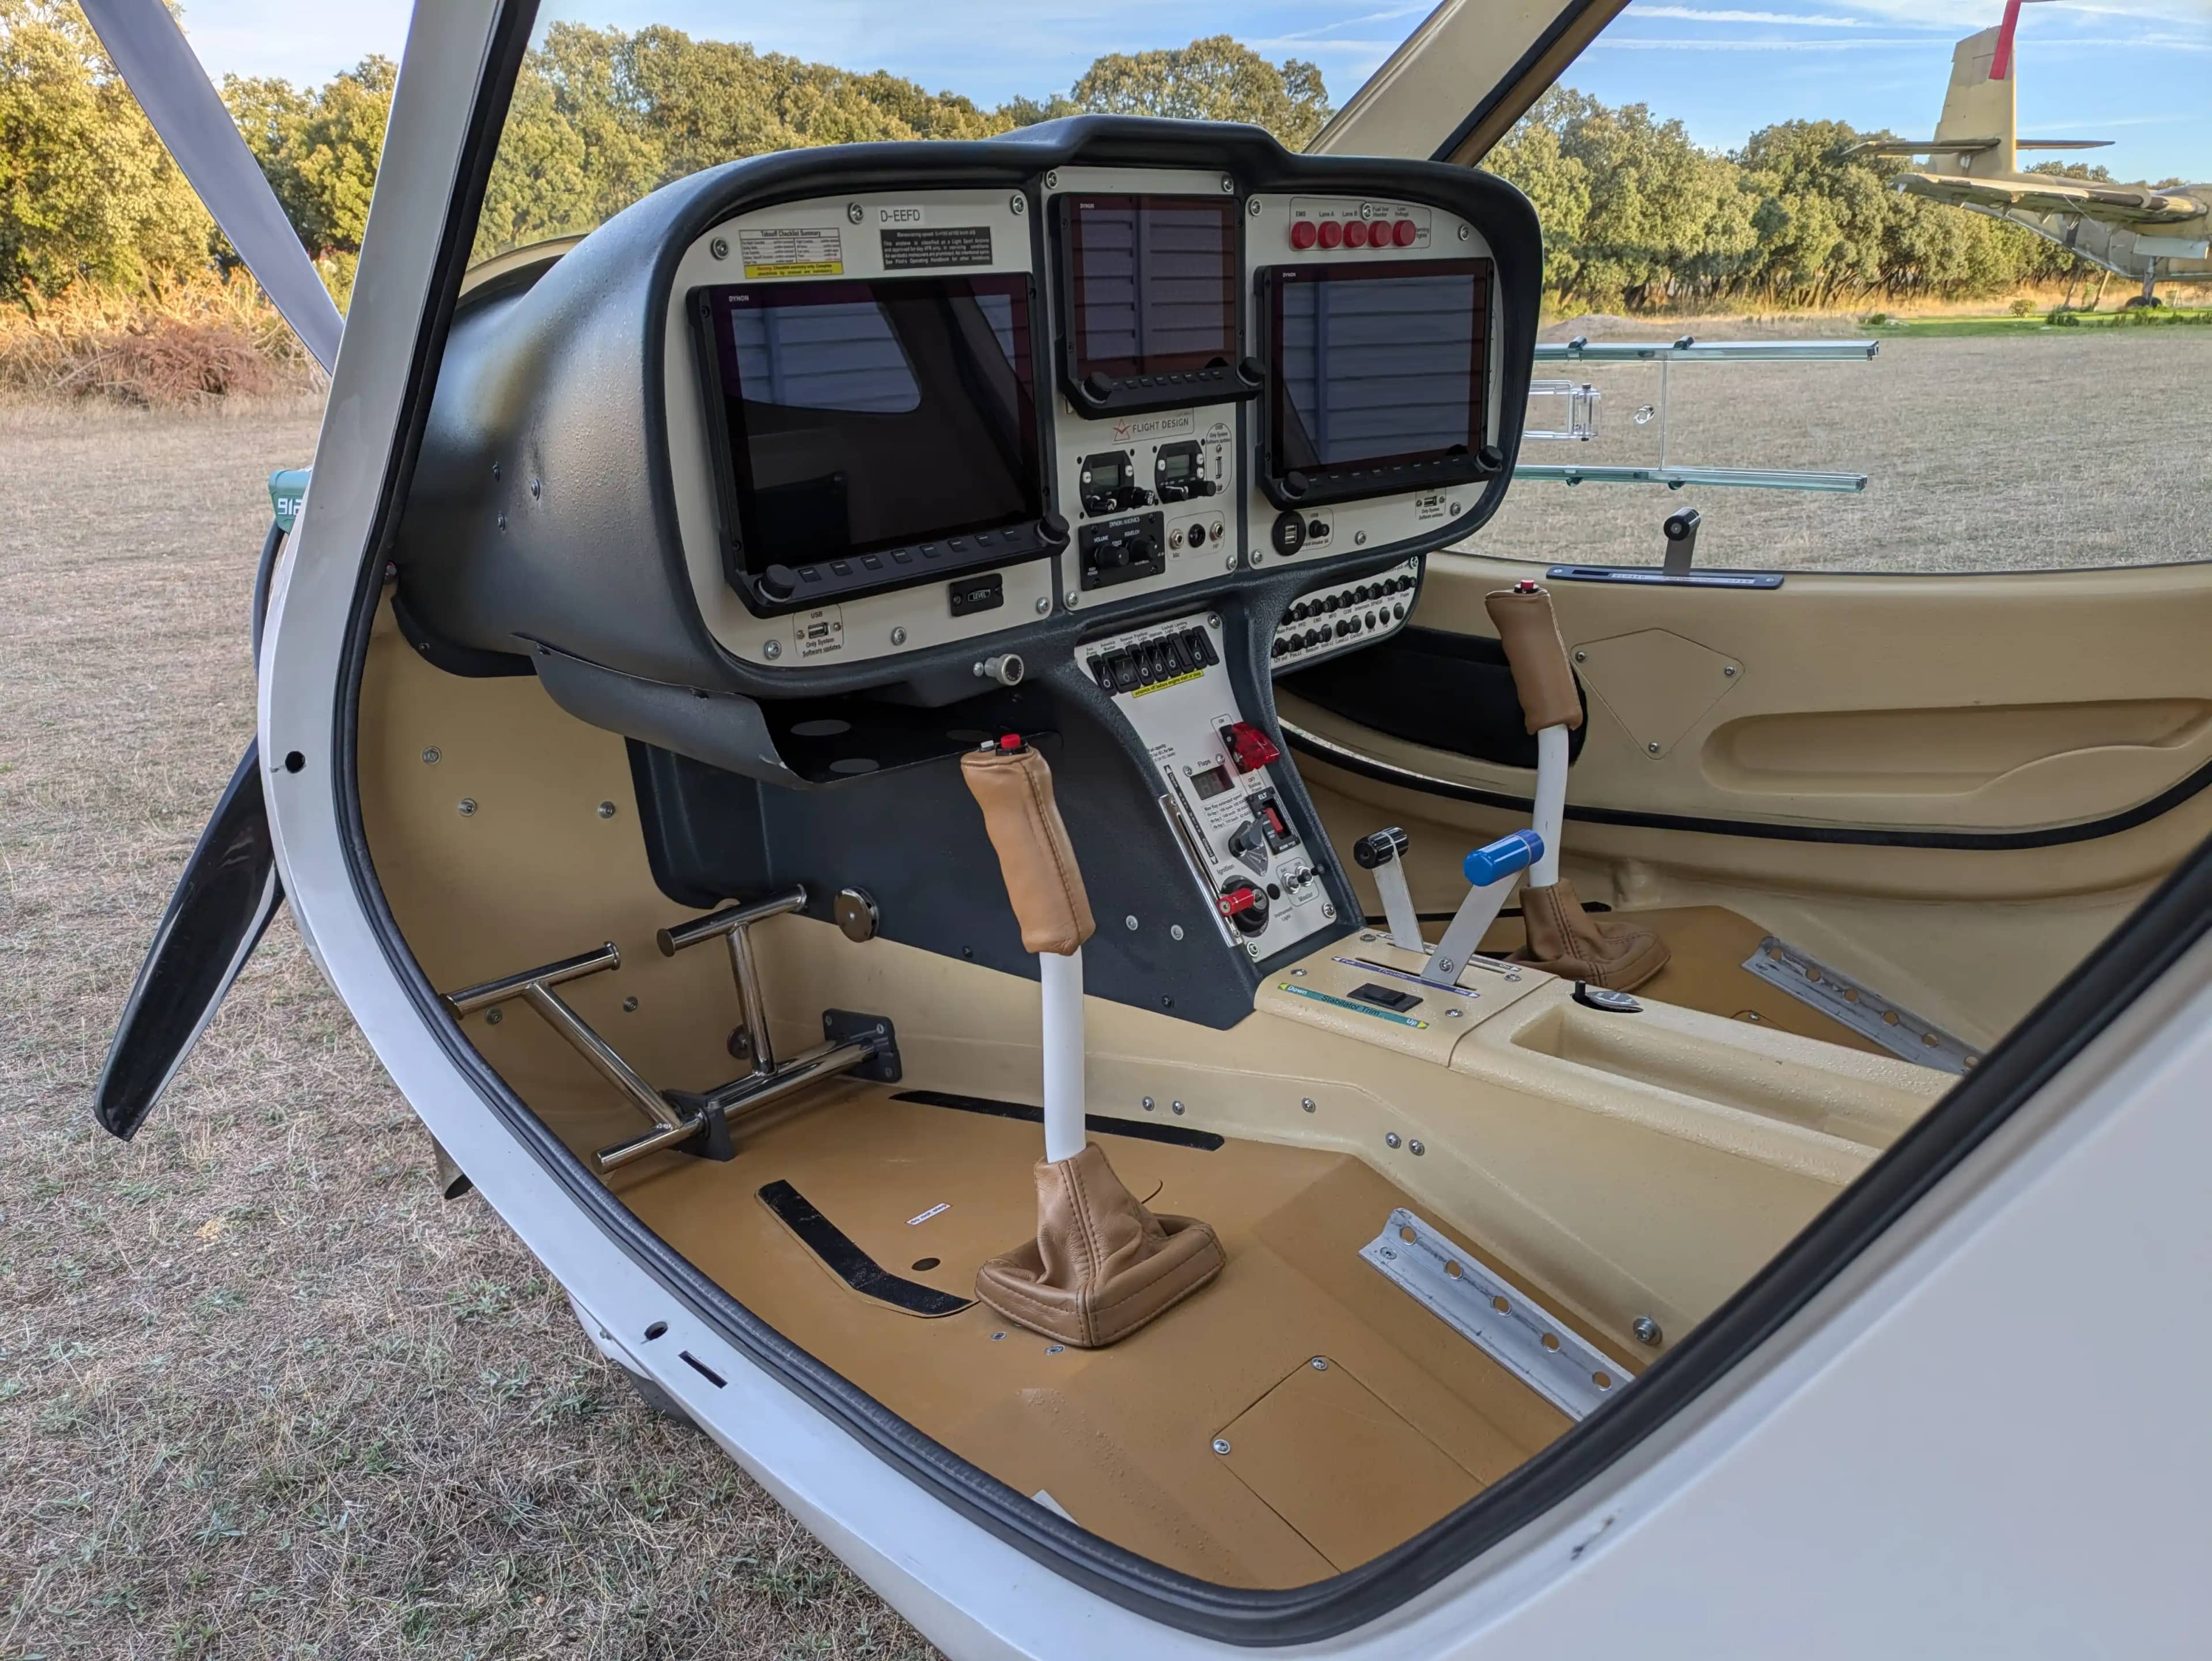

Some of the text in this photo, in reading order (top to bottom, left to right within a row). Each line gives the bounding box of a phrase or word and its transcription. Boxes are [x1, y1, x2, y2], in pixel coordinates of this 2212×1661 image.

[880, 210, 921, 222] D-EEFD
[1132, 418, 1189, 433] FLIGHT DESIGN
[1109, 516, 1140, 528] DYNON AVIONICS
[974, 592, 987, 600] LEVEL
[810, 611, 823, 619] USB
[802, 644, 842, 658] Software updates
[1197, 759, 1211, 767] Flaps
[1169, 773, 1178, 788] Open
[1257, 792, 1267, 800] ELT
[1202, 838, 1214, 857] Closed
[1217, 864, 1235, 875] Ignition
[1298, 892, 1313, 902] Master
[1377, 968, 1408, 979] Throttle
[1287, 985, 1308, 996] Down
[1321, 995, 1381, 1017] Stabilator Trim
[1406, 1018, 1418, 1026] Up
